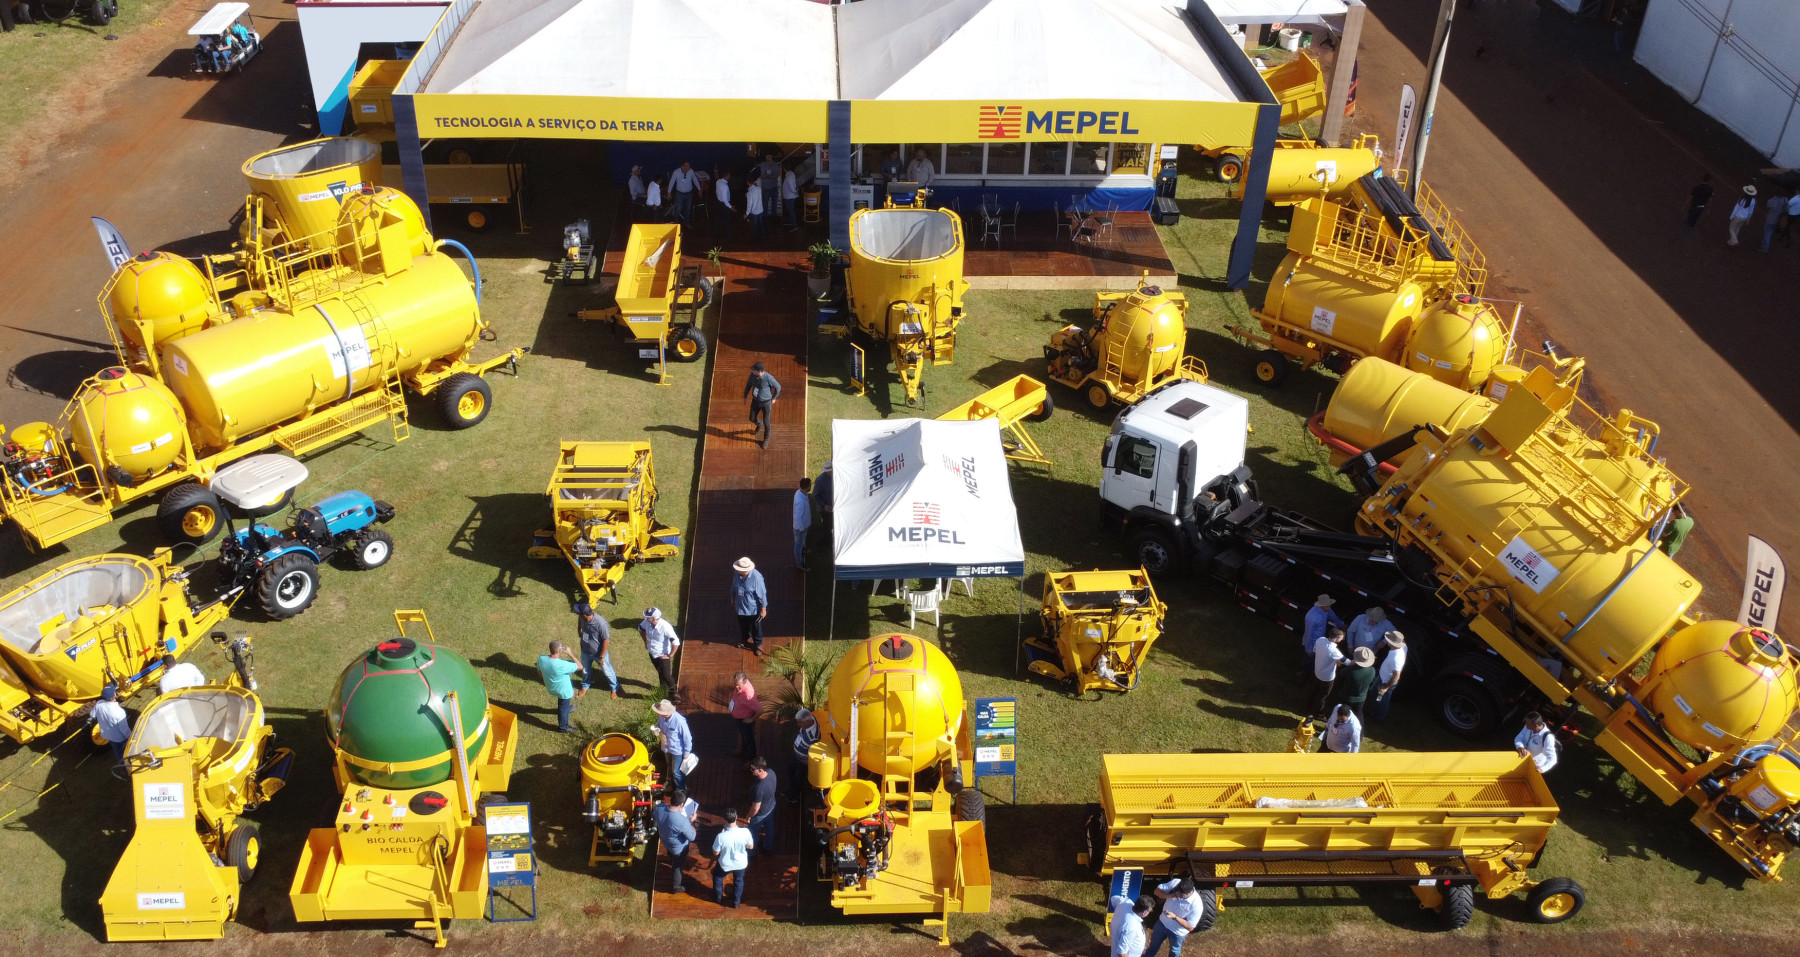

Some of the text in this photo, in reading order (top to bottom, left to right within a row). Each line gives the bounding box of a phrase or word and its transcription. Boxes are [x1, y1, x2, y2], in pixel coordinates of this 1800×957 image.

[434, 116, 666, 132] TECNOLOGIA A SERVIÇO DA TERRA
[1025, 110, 1140, 135] MEPEL
[1397, 100, 1413, 151] MEPEL
[1118, 157, 1146, 167] MAIS
[309, 191, 330, 200] MEPEL
[333, 185, 351, 196] 10.0
[1313, 313, 1333, 326] MEPEL
[332, 341, 364, 360] MPEL
[867, 453, 885, 498] MEPEL
[961, 456, 981, 499] MEPEL
[888, 526, 967, 545] MEPEL
[971, 566, 1009, 575] MEPEL
[1504, 551, 1540, 586] MEPEL
[493, 740, 506, 761] MEPEL
[150, 795, 178, 803] MEPEL
[388, 836, 425, 844] CALDA
